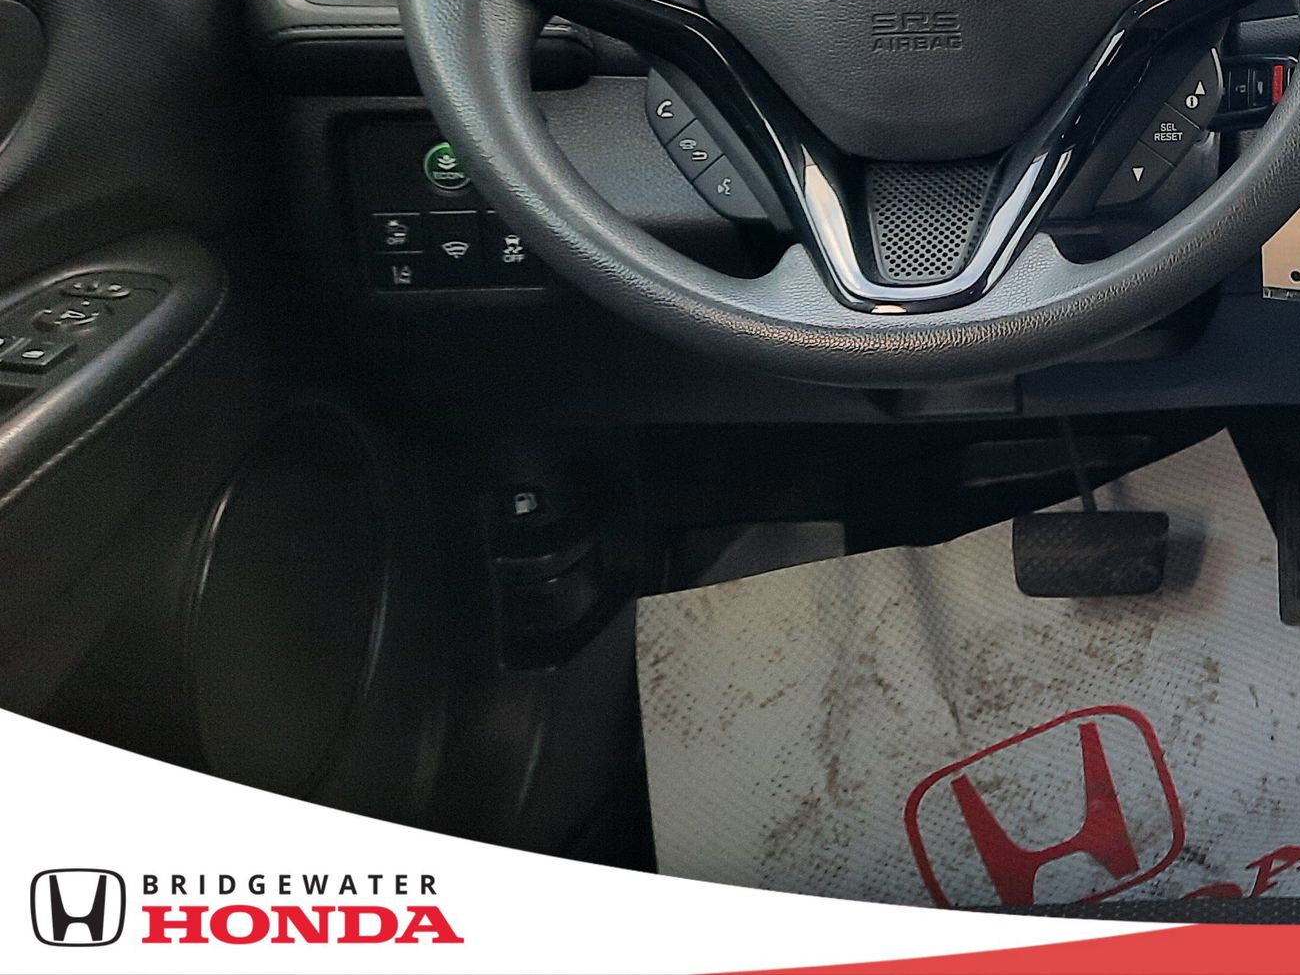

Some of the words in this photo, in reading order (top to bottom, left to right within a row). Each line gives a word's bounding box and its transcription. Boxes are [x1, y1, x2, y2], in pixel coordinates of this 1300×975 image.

[871, 12, 960, 32] SRS
[872, 36, 962, 53] AIRBAG
[1160, 122, 1177, 131] SEL
[1153, 131, 1184, 142] RESET
